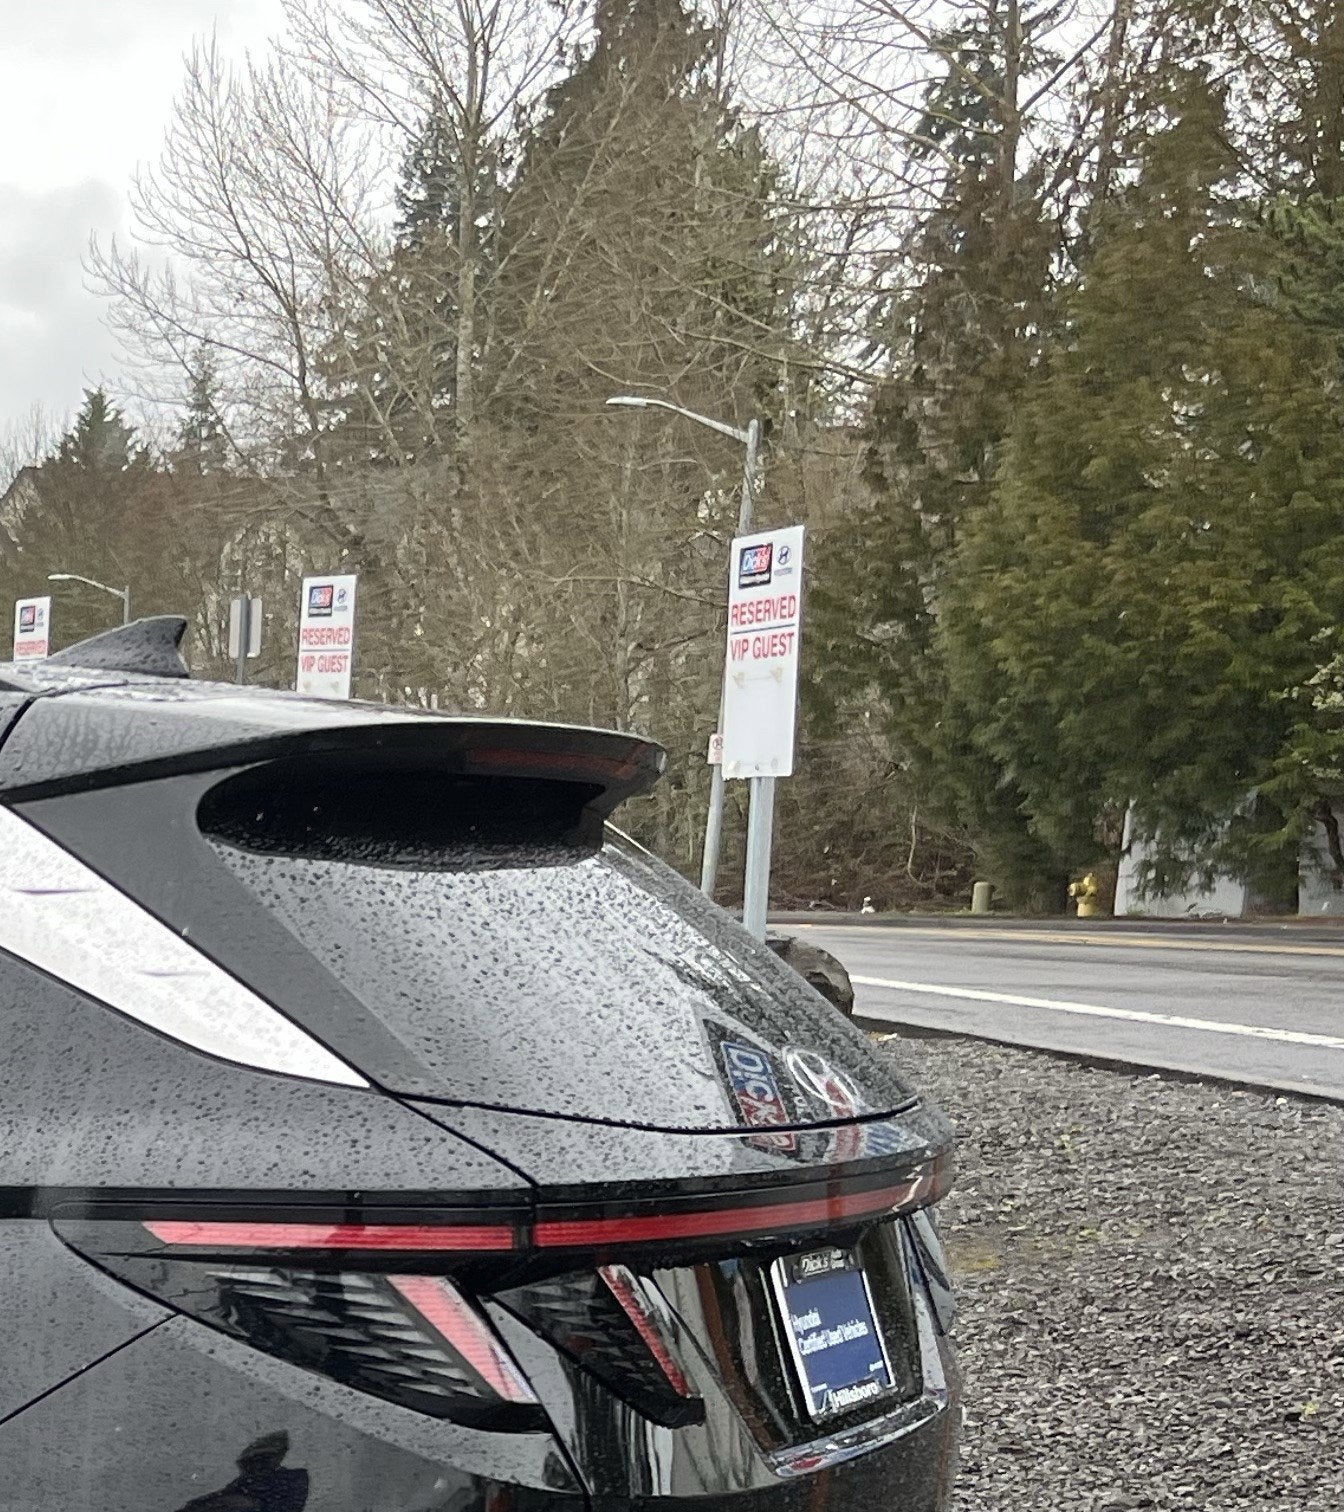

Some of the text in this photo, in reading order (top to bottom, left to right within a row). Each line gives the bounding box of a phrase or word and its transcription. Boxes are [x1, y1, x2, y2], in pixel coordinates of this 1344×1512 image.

[730, 596, 796, 627] RESERVED
[301, 627, 351, 645] RESERVED
[730, 633, 795, 661] VIP GUEST
[300, 655, 349, 673] VIP GUEST
[833, 1380, 880, 1408] Hillsboro
